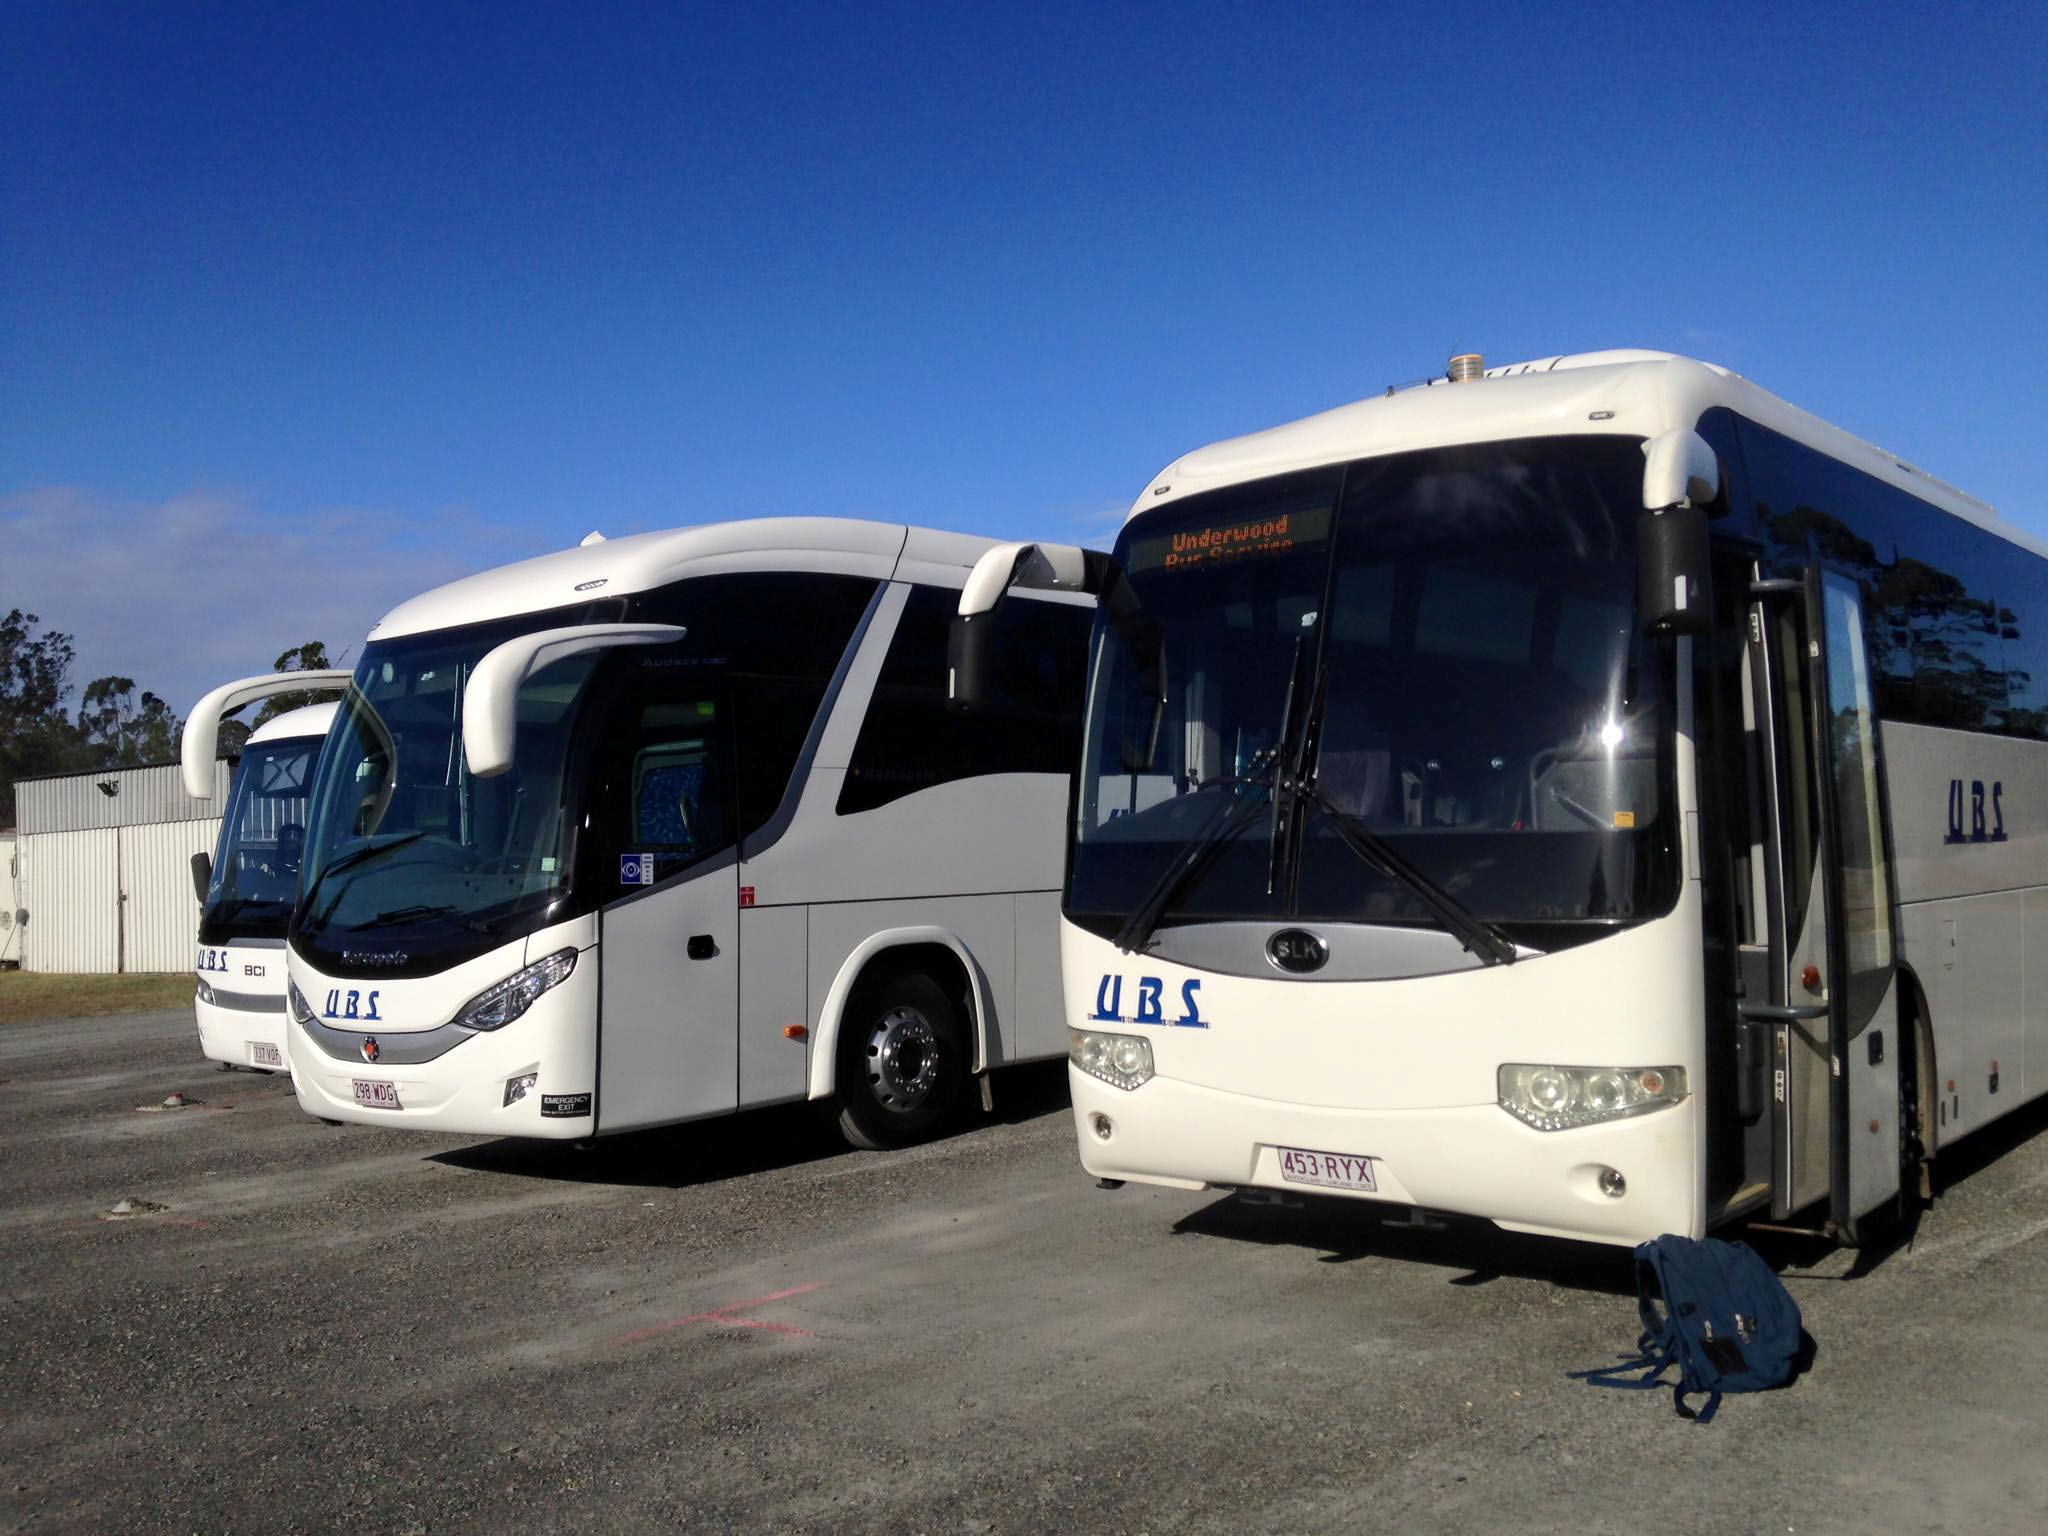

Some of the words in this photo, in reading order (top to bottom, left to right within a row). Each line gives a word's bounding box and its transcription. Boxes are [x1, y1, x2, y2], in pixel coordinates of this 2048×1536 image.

[1172, 514, 1289, 551] Underwood
[1944, 779, 2008, 845] UBS
[197, 949, 228, 972] UBS
[244, 965, 265, 977] BCI
[321, 989, 382, 1021] UBS
[1087, 974, 1211, 1029] UBS
[544, 1095, 588, 1104] EMERGENCY
